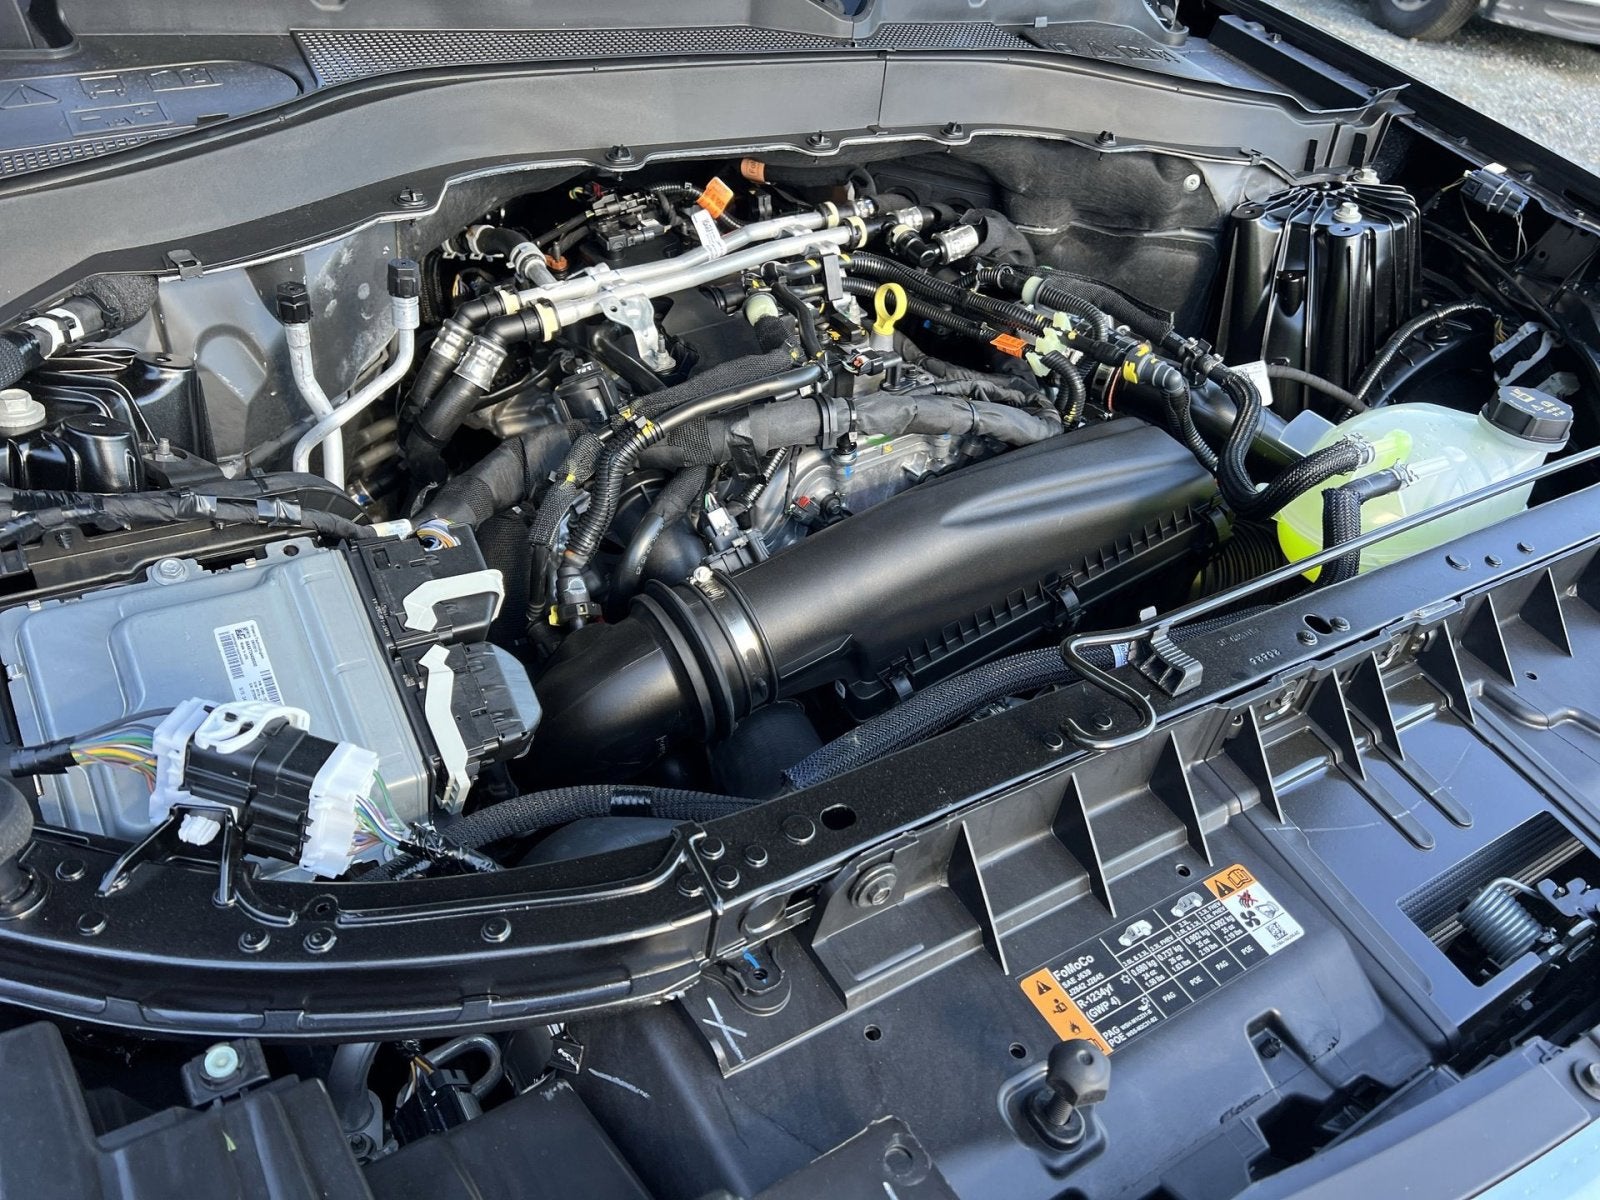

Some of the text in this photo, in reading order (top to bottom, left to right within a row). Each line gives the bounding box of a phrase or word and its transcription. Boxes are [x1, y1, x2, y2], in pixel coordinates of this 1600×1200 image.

[1172, 944, 1184, 952] kg
[1240, 944, 1254, 955] POE
[1052, 955, 1094, 981] FoMoCo
[1145, 959, 1158, 967] kg
[1215, 960, 1229, 970] PAG
[1062, 977, 1076, 988] SAE
[1189, 975, 1203, 986] POE
[1076, 983, 1114, 1009] R-1234yf
[1162, 991, 1176, 1002] PAG
[1085, 995, 1121, 1021] (GWP 4)
[1102, 1026, 1120, 1040] PAG
[1108, 1032, 1127, 1047] POE
